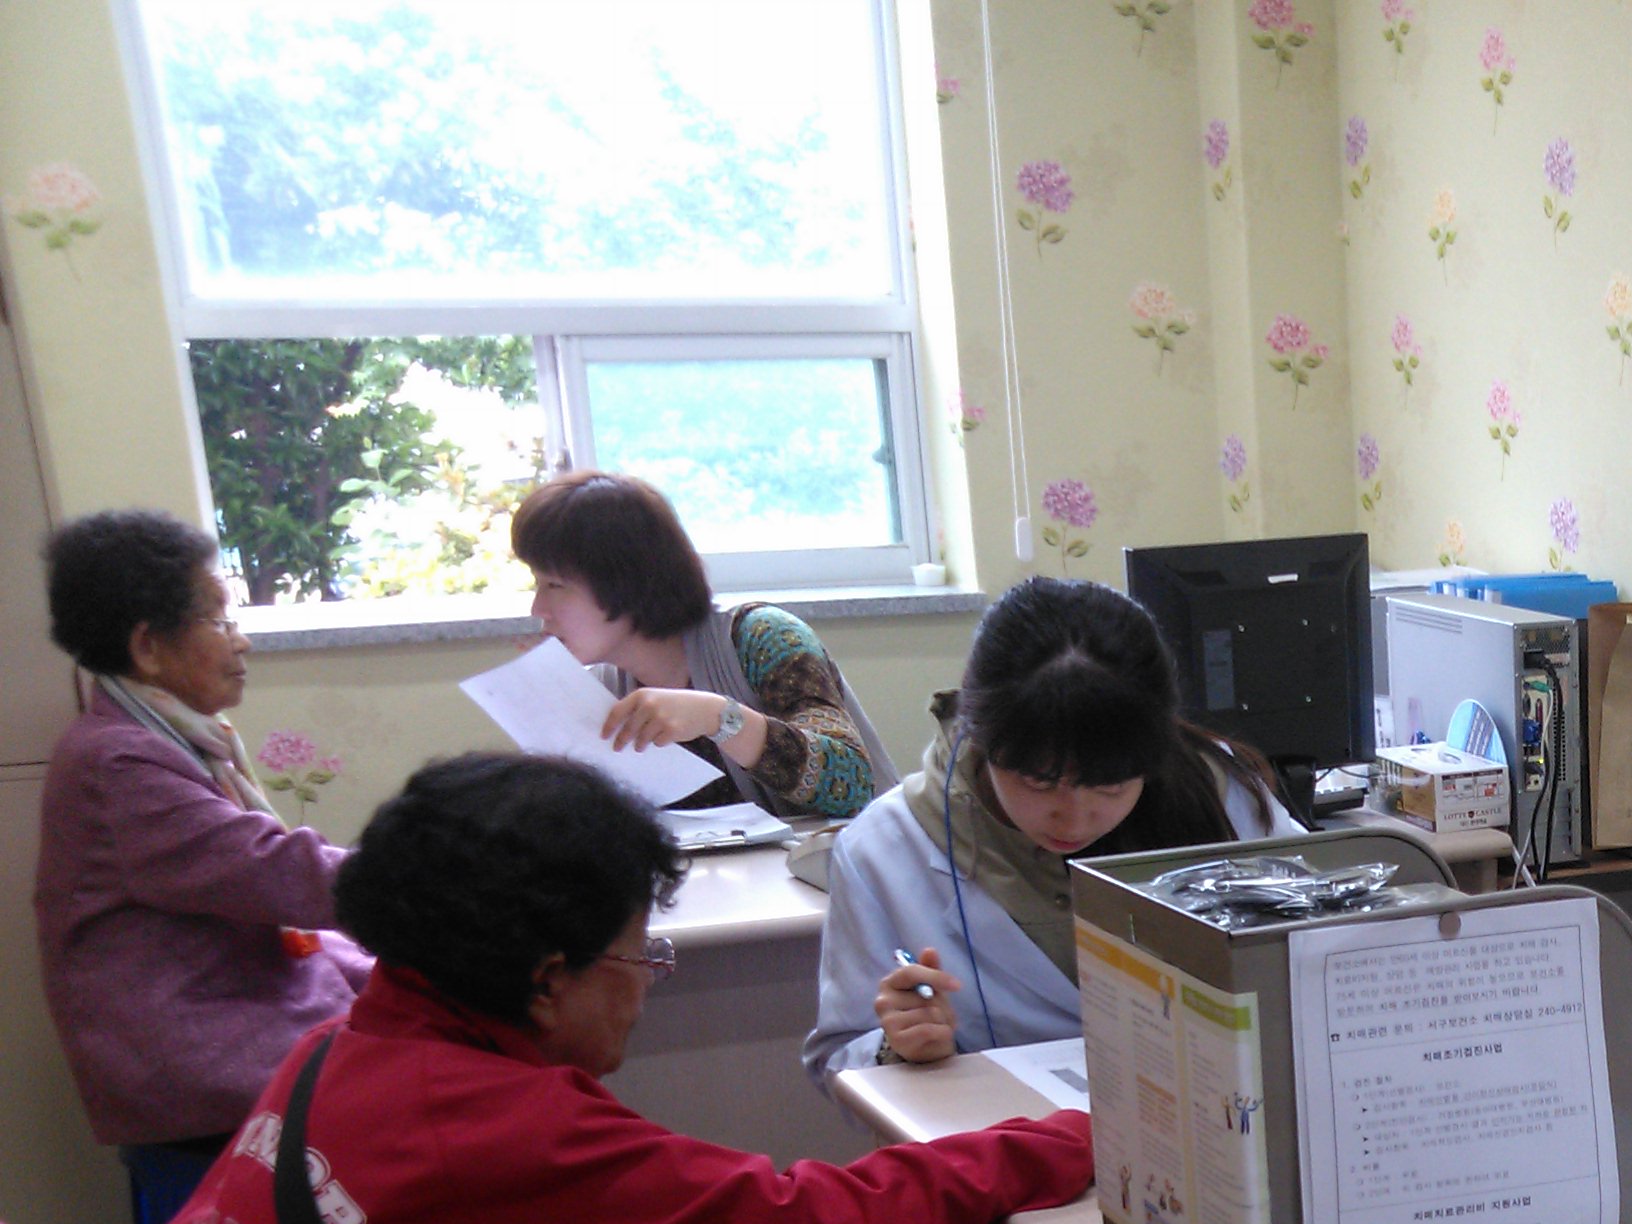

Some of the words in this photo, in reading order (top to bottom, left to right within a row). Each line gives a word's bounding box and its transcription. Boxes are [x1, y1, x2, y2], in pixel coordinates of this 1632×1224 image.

[1537, 1002, 1583, 1016] 240-4912
[1422, 1043, 1503, 1061] 치매조기검진사업
[1413, 1203, 1485, 1221] 치매치료관리비
[1490, 1195, 1531, 1210] 지원사업
